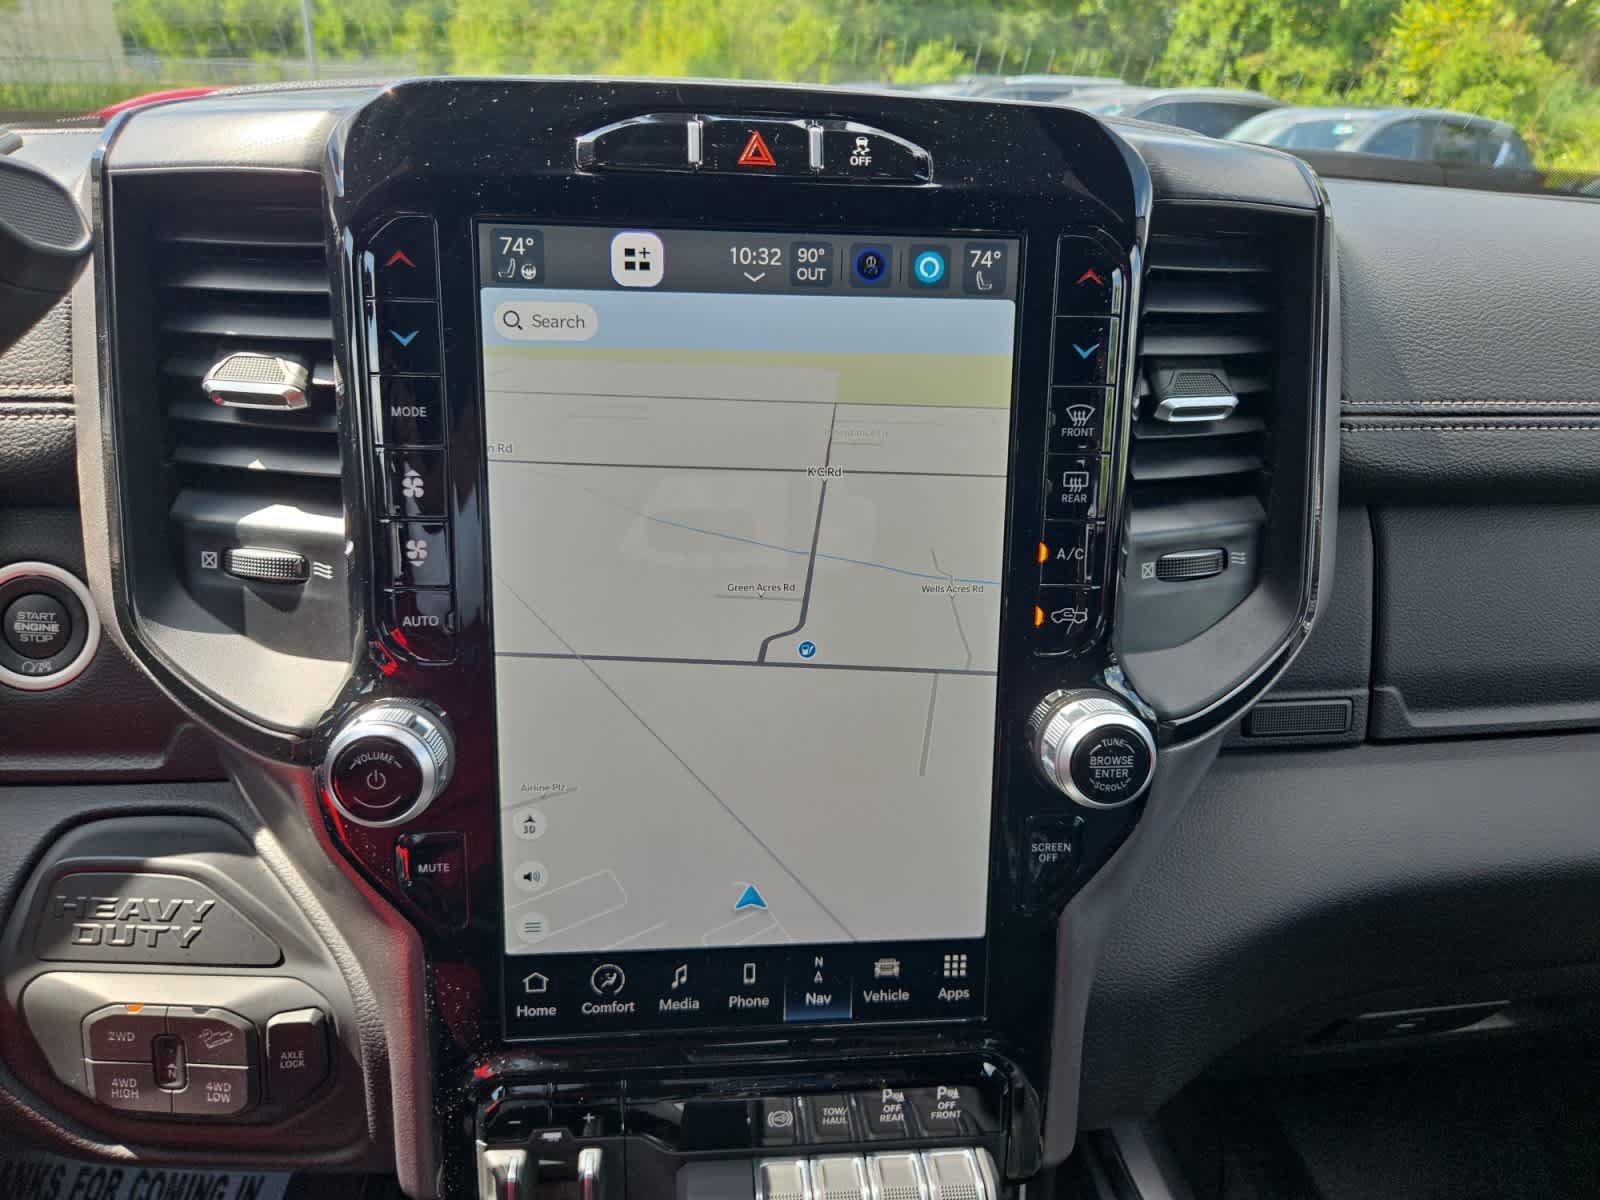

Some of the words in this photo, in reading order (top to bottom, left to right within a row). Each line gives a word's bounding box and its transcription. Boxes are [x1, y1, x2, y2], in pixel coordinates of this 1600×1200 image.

[849, 154, 873, 167] OFF
[498, 235, 535, 256] 74°
[729, 247, 782, 266] 10:32
[797, 248, 825, 263] 90°
[969, 250, 1002, 268] 74°
[796, 268, 826, 281] OUT
[531, 313, 586, 329] Search
[391, 405, 427, 418] MODE
[1061, 427, 1094, 438] FRONT
[497, 442, 513, 454] Rd
[827, 466, 842, 477] Rd
[1061, 493, 1087, 503] REAR
[1056, 549, 1085, 561] A/C
[727, 583, 754, 592] Green
[756, 583, 781, 592] Acres
[783, 583, 796, 592] Rd
[921, 584, 945, 593] Wells
[946, 584, 971, 593] Acres
[972, 584, 984, 593] Rd
[16, 611, 56, 621] START
[402, 614, 440, 627] AUTO
[13, 622, 60, 633] ENGINE
[19, 634, 54, 643] STOP
[1101, 737, 1127, 747] TUNE
[354, 752, 395, 766] VOLUME
[1089, 755, 1134, 766] BROWSE
[1095, 768, 1129, 779] ENTER
[1093, 779, 1129, 793] SCROLL
[523, 824, 536, 834] 3D
[1031, 841, 1071, 853] SCREEN
[1038, 853, 1058, 864] OFF
[417, 862, 451, 874] MUTE
[55, 895, 215, 923] HEAVY
[71, 923, 202, 949] DUTY
[805, 992, 832, 1006] Nav
[863, 988, 910, 1003] Vehicle
[937, 986, 971, 1002] Apps
[659, 998, 701, 1012] Media
[728, 994, 771, 1009] Phone
[516, 1004, 557, 1018] Home
[581, 1001, 636, 1015] Comfort
[107, 1031, 136, 1042] 2WD
[280, 1051, 304, 1060] AXLE
[279, 1060, 305, 1069] LOCK
[111, 1078, 137, 1088] 4WD
[206, 1082, 232, 1093] 4WD
[111, 1088, 140, 1099] HIGH
[207, 1092, 231, 1103] LOW
[883, 1104, 902, 1113] OFF
[937, 1101, 956, 1110] OFF
[879, 1113, 904, 1123] REAR
[930, 1110, 962, 1120] FRONT
[822, 1117, 848, 1126] HAUL
[70, 1166, 123, 1200] FOR
[129, 1168, 229, 1200] COMING
[234, 1172, 265, 1200] IN
